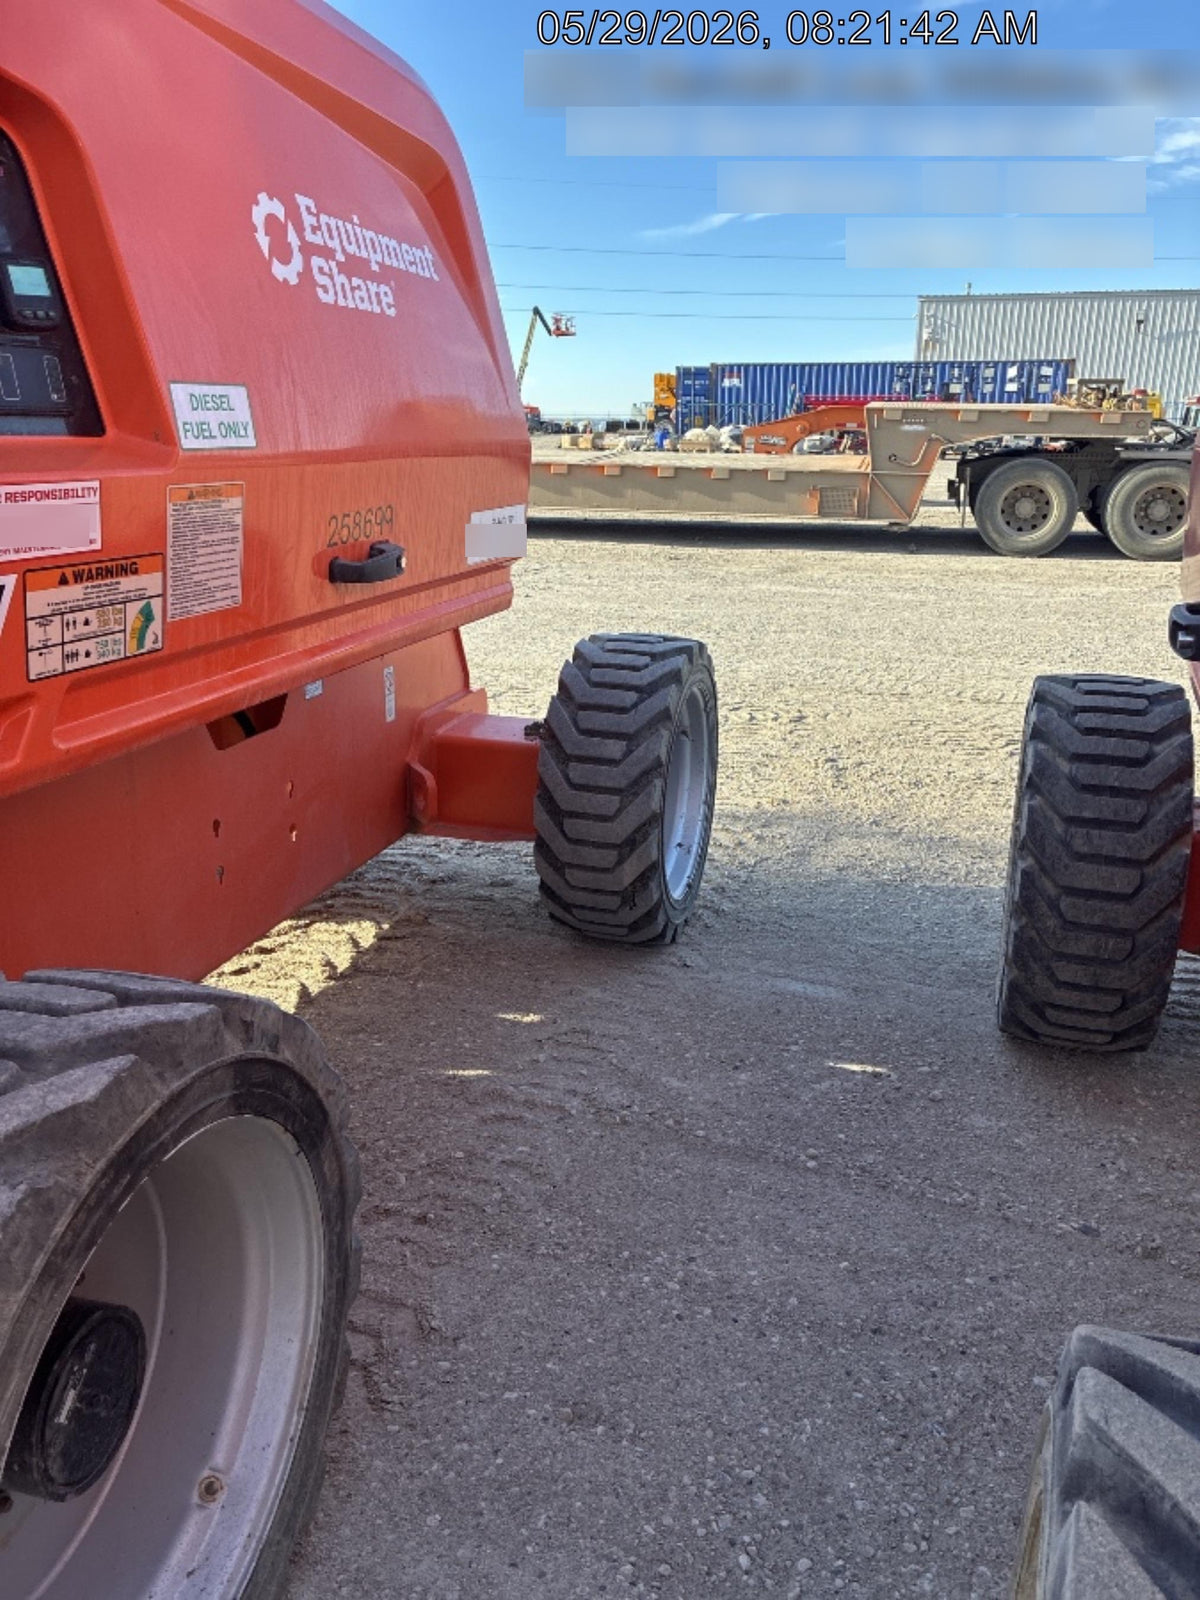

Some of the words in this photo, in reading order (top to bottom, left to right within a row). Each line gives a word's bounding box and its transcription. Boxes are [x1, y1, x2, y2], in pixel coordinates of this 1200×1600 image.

[294, 193, 440, 281] Equipment
[310, 255, 397, 317] Share
[189, 393, 236, 412] DIESEL
[182, 421, 217, 440] FUEL
[218, 421, 250, 439] ONLY
[4, 486, 98, 504] RESPONSIBILITY
[326, 504, 394, 548] 258699
[72, 561, 139, 584] WARNING
